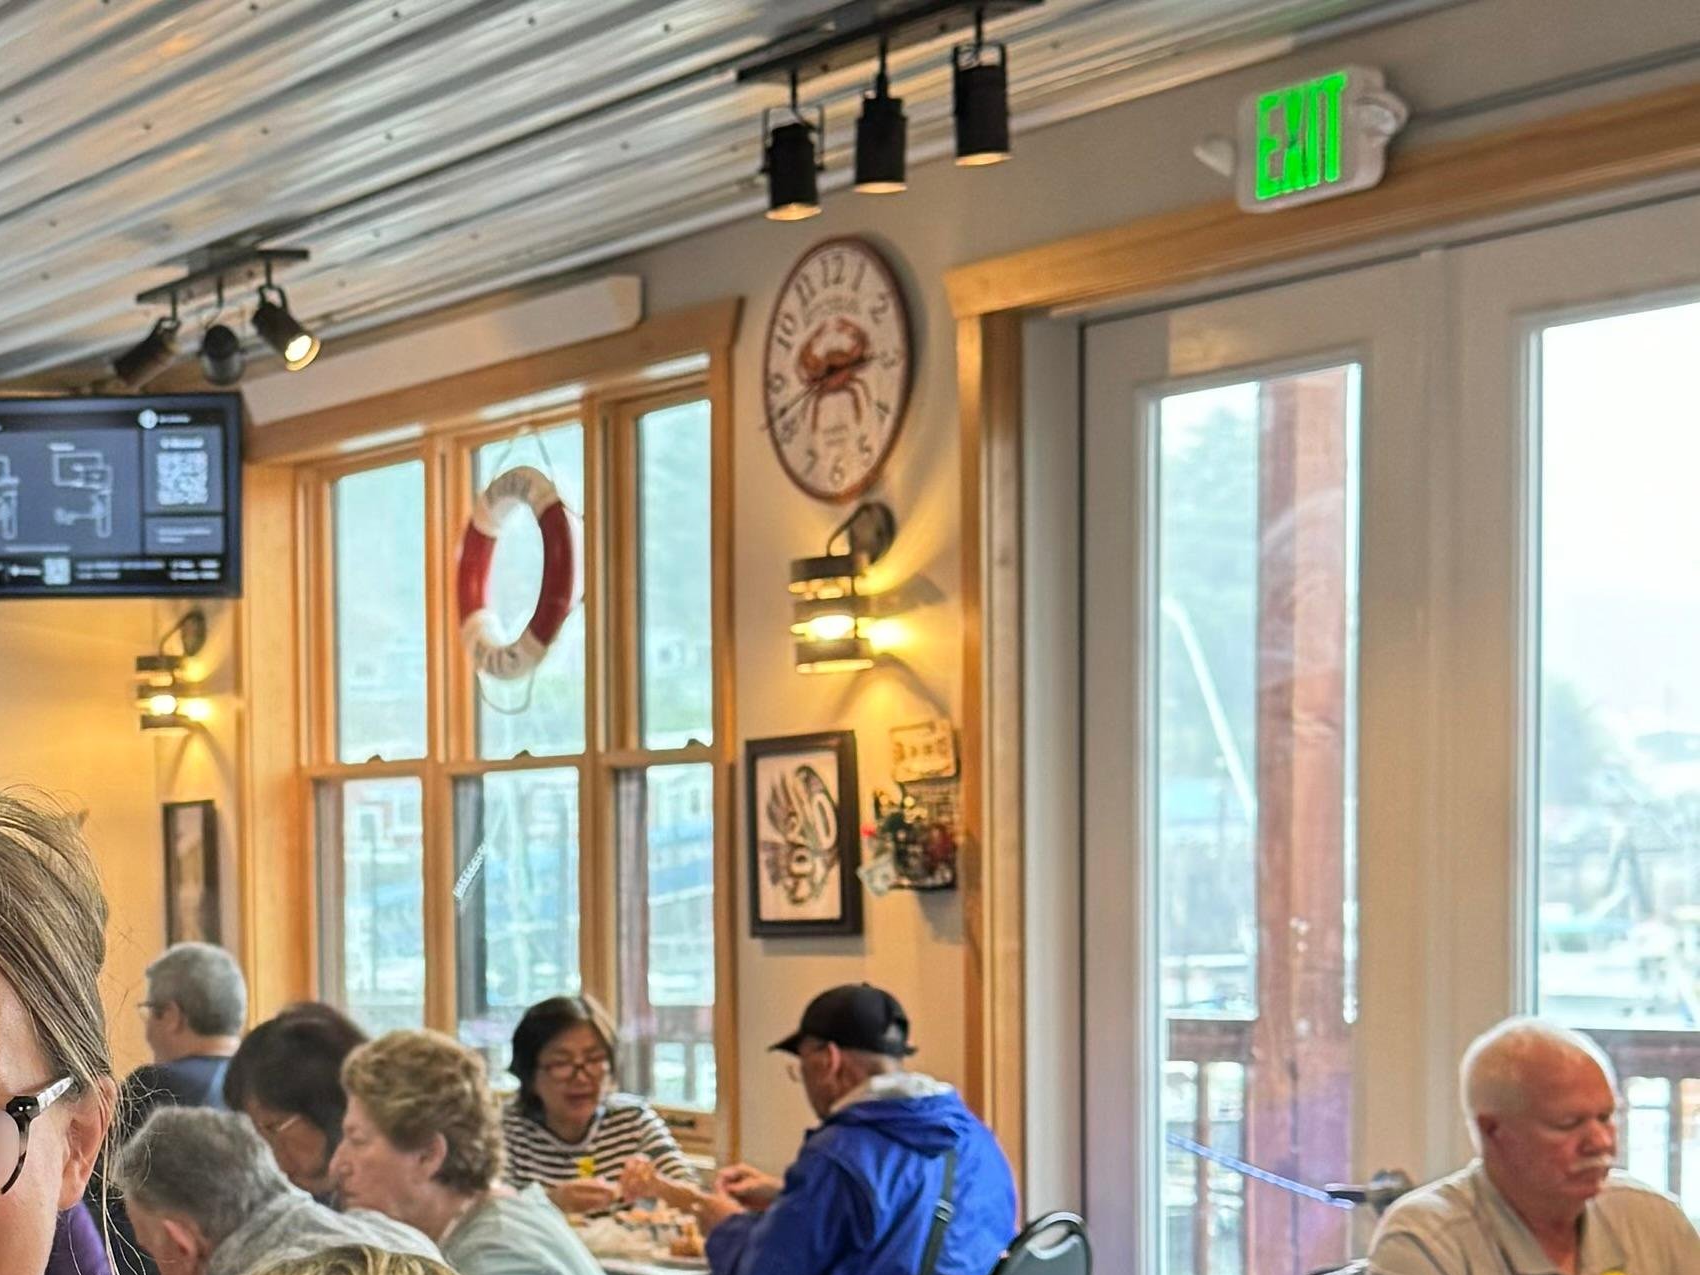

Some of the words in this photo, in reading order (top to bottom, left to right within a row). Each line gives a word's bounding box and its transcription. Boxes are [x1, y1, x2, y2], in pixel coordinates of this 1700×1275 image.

[1256, 71, 1347, 200] EXIT
[821, 255, 845, 288] 12
[851, 262, 866, 292] 1
[795, 273, 817, 306] 11
[868, 290, 890, 325] 2
[776, 312, 795, 350] 10
